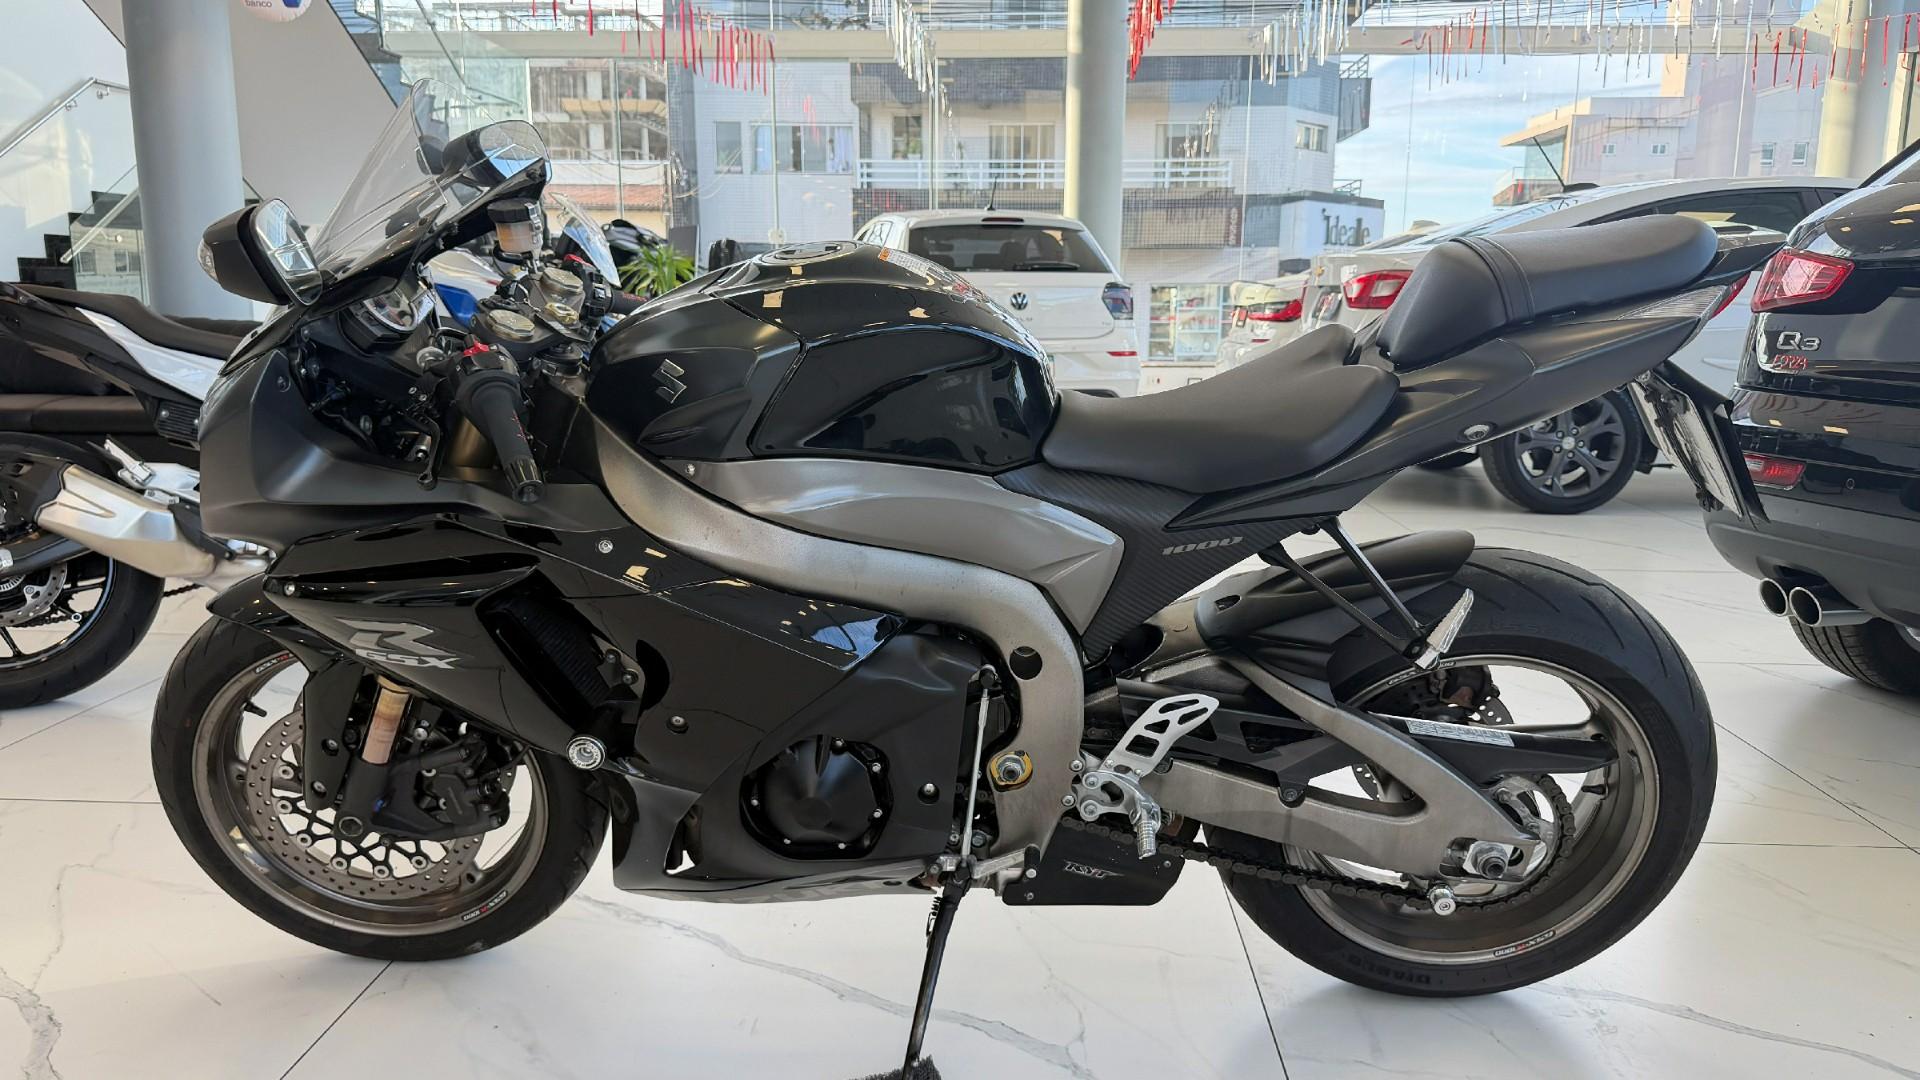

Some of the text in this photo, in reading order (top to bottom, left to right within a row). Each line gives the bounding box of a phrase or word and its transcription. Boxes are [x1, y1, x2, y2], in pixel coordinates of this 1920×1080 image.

[1776, 331, 1820, 350] Q3
[1162, 536, 1244, 556] 1000
[355, 648, 461, 670] GSX
